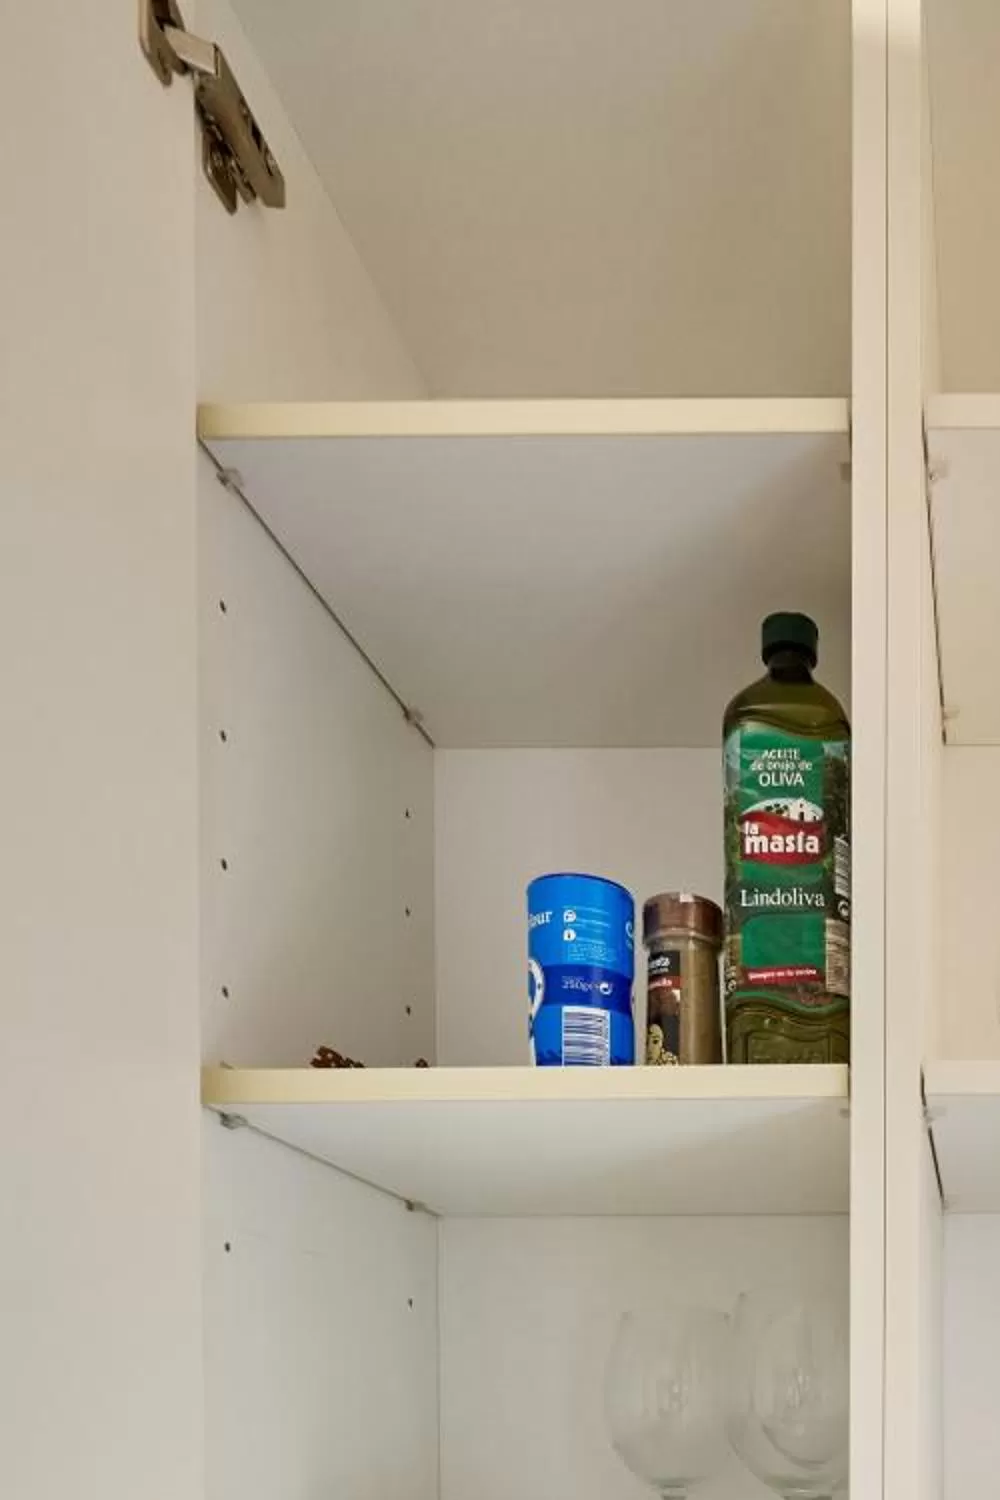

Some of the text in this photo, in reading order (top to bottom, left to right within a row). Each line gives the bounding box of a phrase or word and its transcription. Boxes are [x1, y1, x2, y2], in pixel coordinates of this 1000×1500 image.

[758, 772, 805, 787] OLIVA
[743, 820, 760, 835] la
[740, 888, 826, 907] Lindoliva
